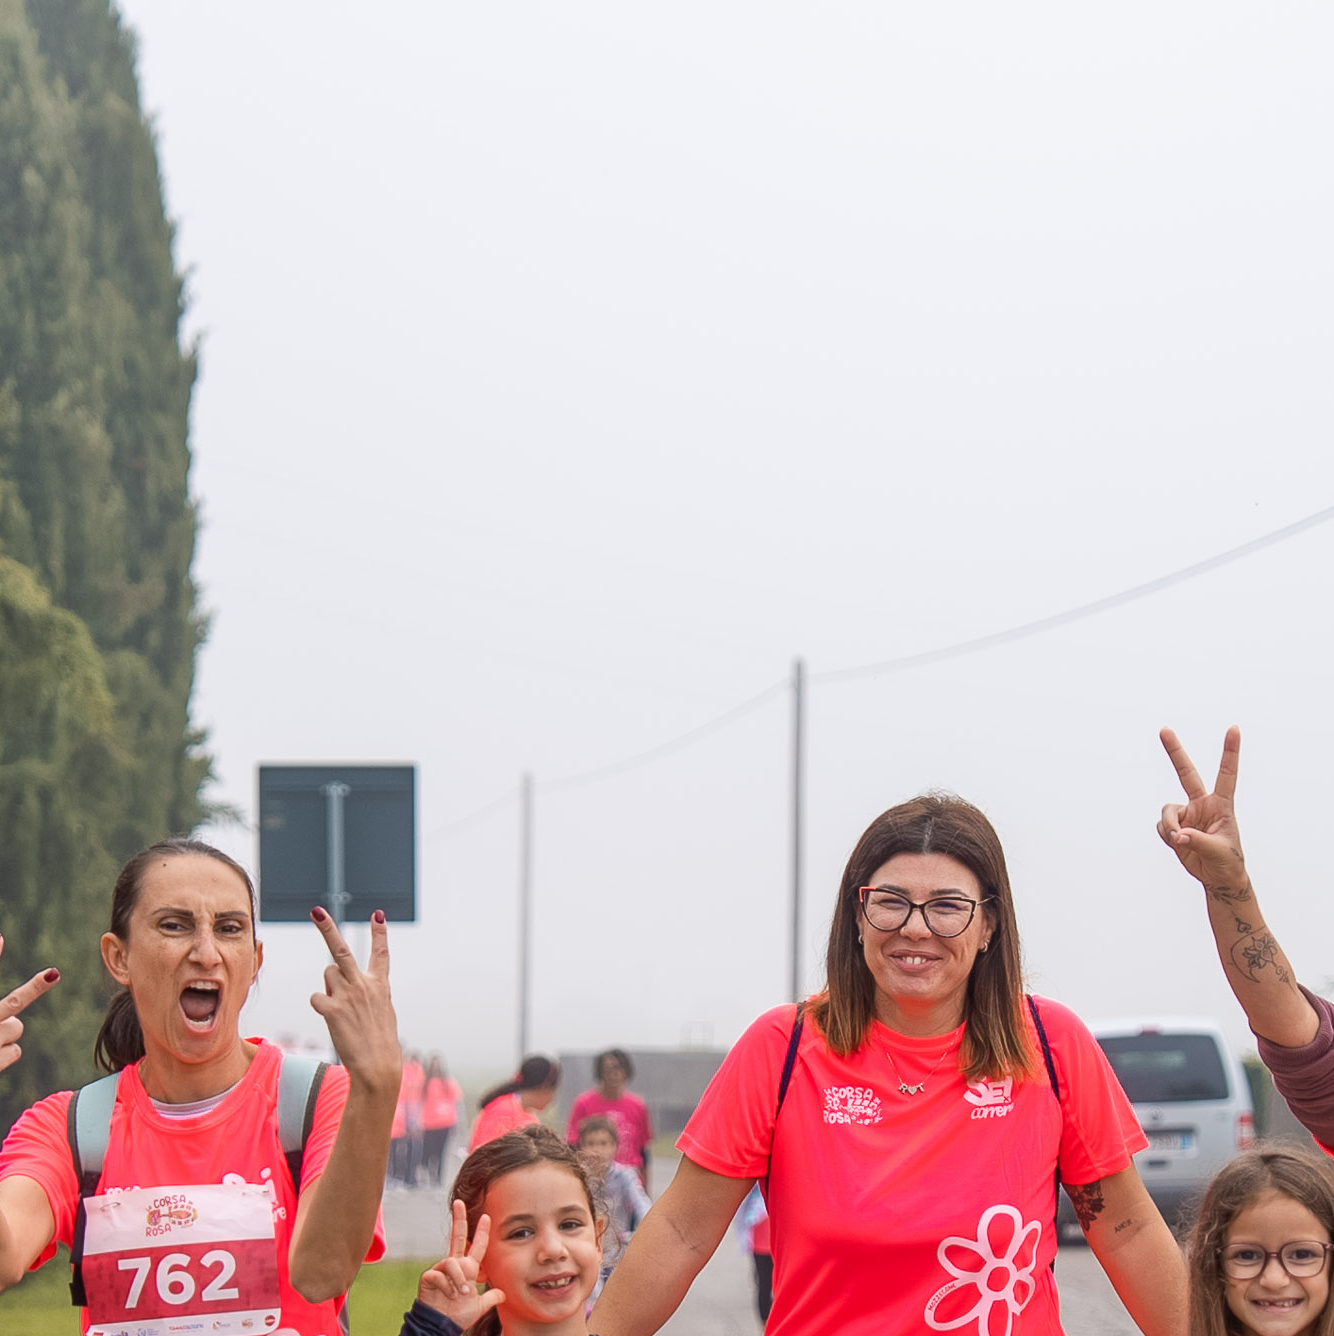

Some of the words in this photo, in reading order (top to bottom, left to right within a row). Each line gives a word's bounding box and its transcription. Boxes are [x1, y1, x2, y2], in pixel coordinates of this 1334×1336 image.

[831, 1086, 874, 1101] CORSA
[823, 1110, 852, 1126] ROSA
[153, 1194, 187, 1209] CORSA
[145, 1223, 172, 1237] ROSA
[117, 1249, 240, 1310] 762
